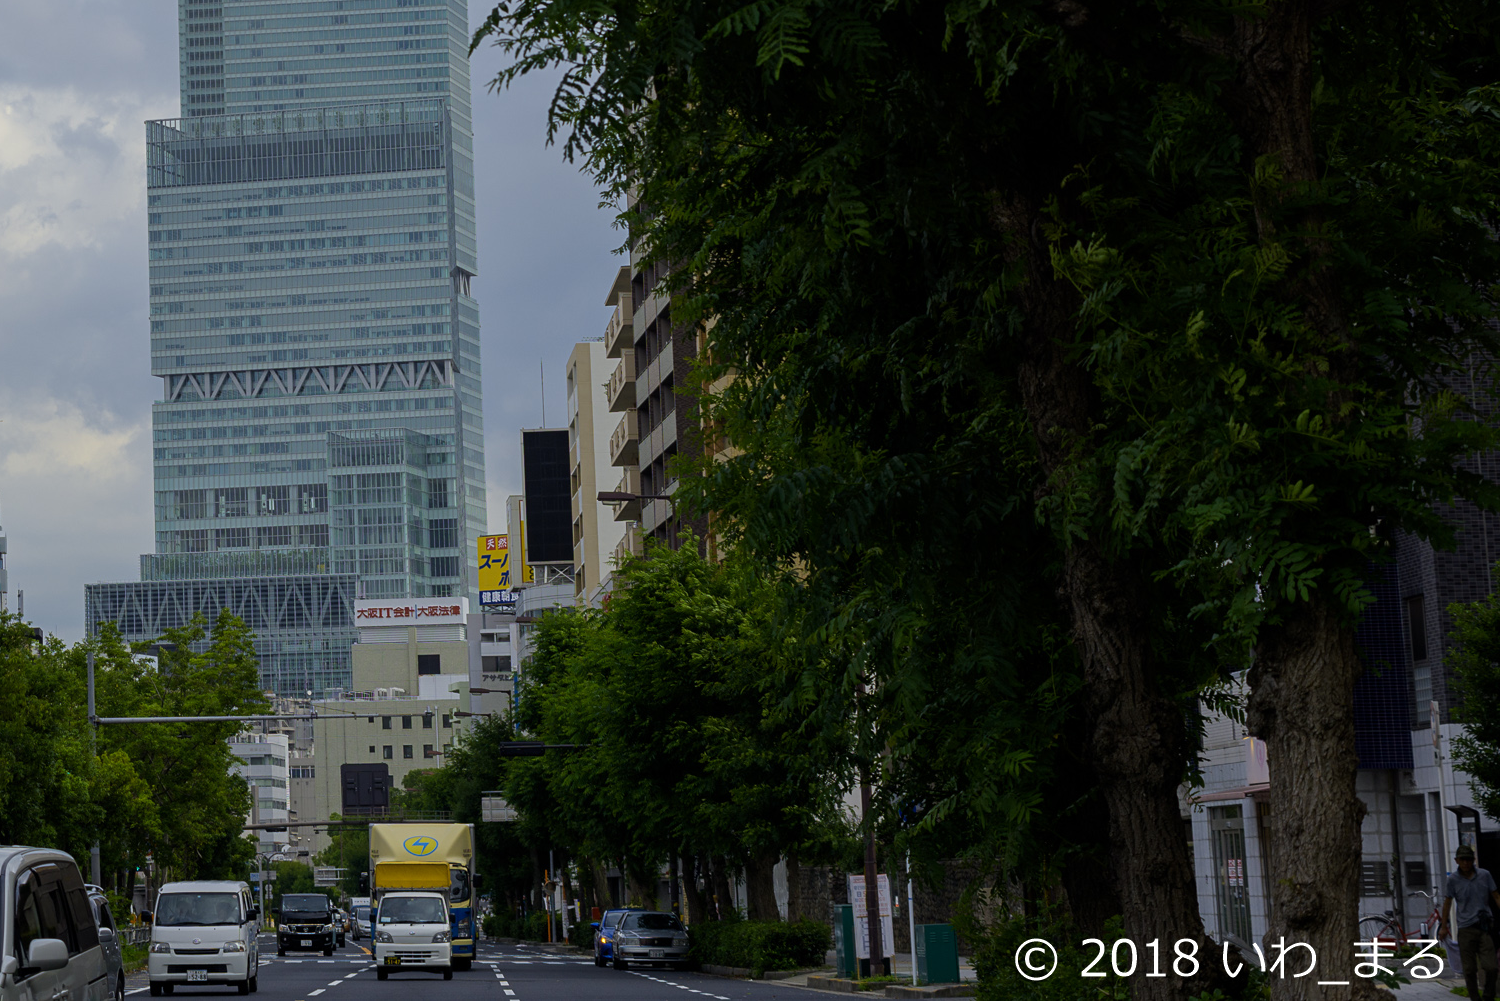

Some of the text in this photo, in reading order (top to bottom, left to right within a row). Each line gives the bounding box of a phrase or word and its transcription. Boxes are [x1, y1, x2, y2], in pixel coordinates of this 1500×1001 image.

[486, 537, 507, 550] 天然
[417, 605, 461, 617] 大阪法律
